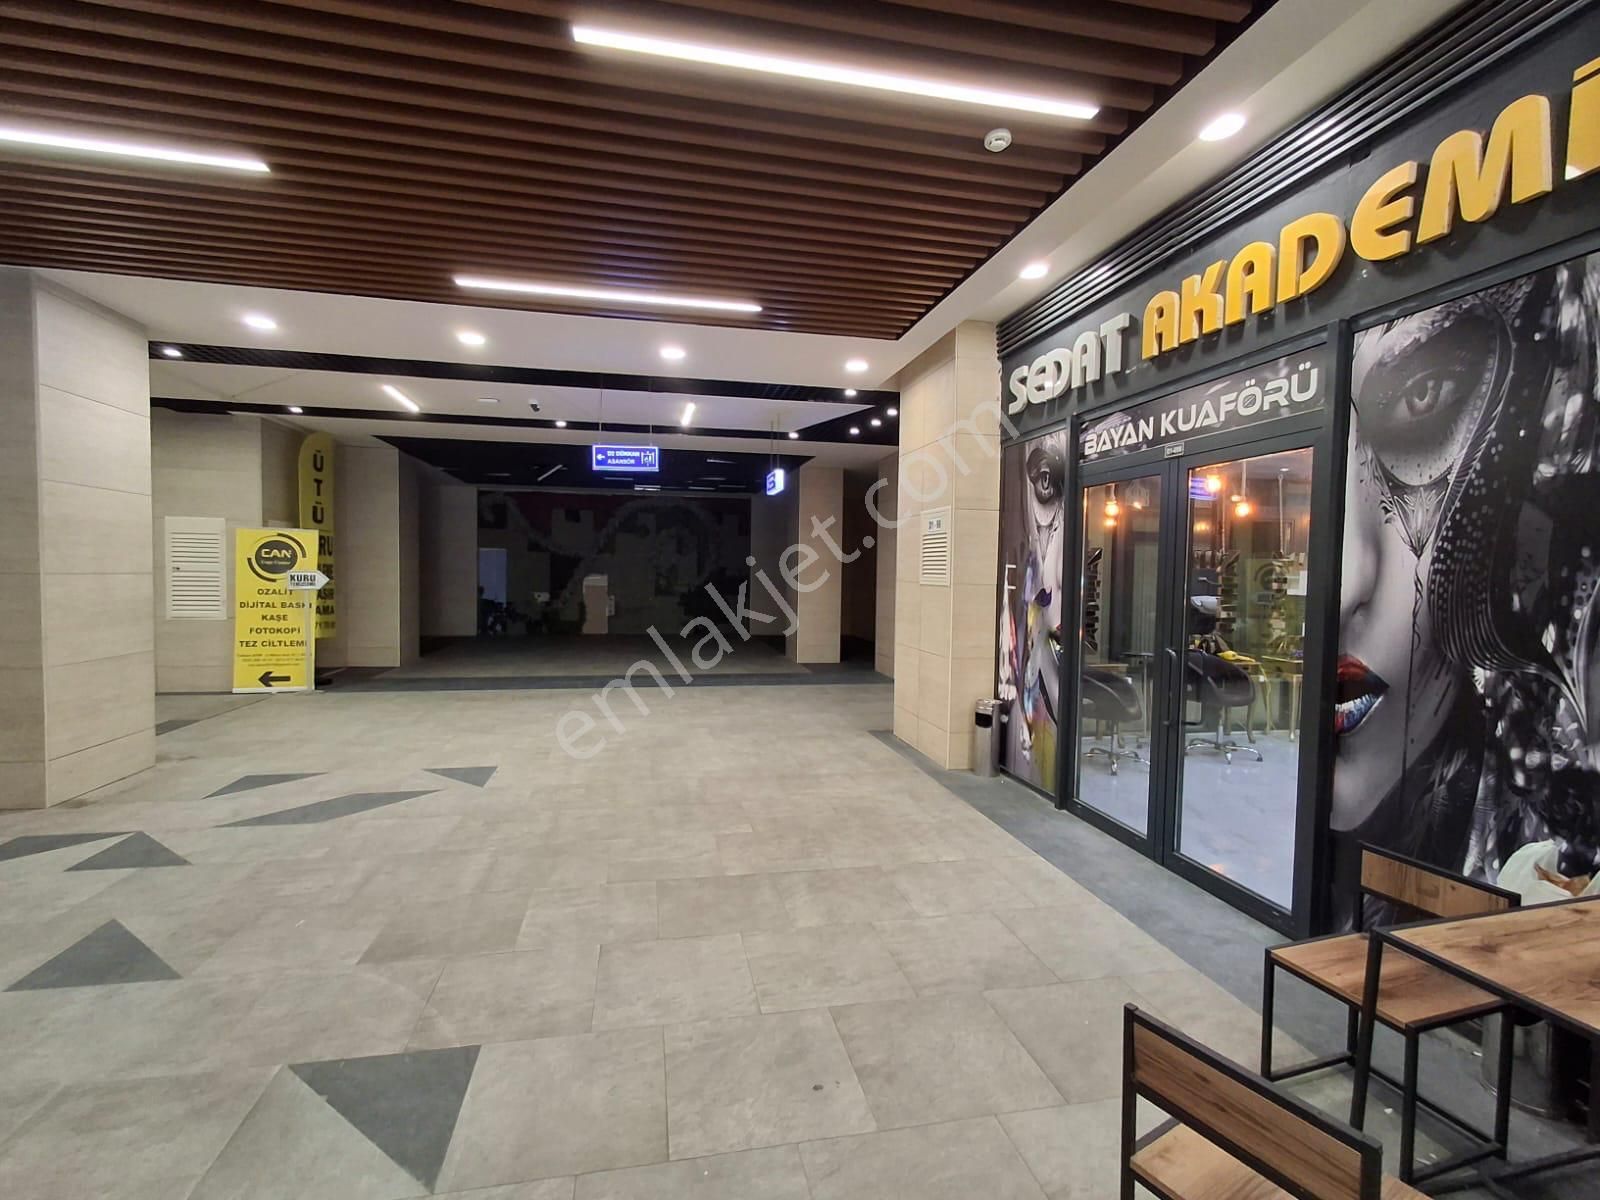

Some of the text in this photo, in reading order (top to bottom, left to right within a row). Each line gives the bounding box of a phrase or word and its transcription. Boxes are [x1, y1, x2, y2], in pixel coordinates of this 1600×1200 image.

[1008, 312, 1132, 416] SEDAT
[1083, 361, 1319, 456] BAYAN KUAFÖRÜ
[311, 449, 325, 525] ÜTÜ
[319, 535, 333, 556] RU
[261, 548, 293, 558] CAN
[290, 574, 316, 582] KURU
[239, 600, 277, 609] DİJİTAL
[261, 614, 288, 623] KAŞE
[249, 626, 301, 635] FOTOKOPİ
[240, 639, 307, 648] TEZ CİLTLEM
